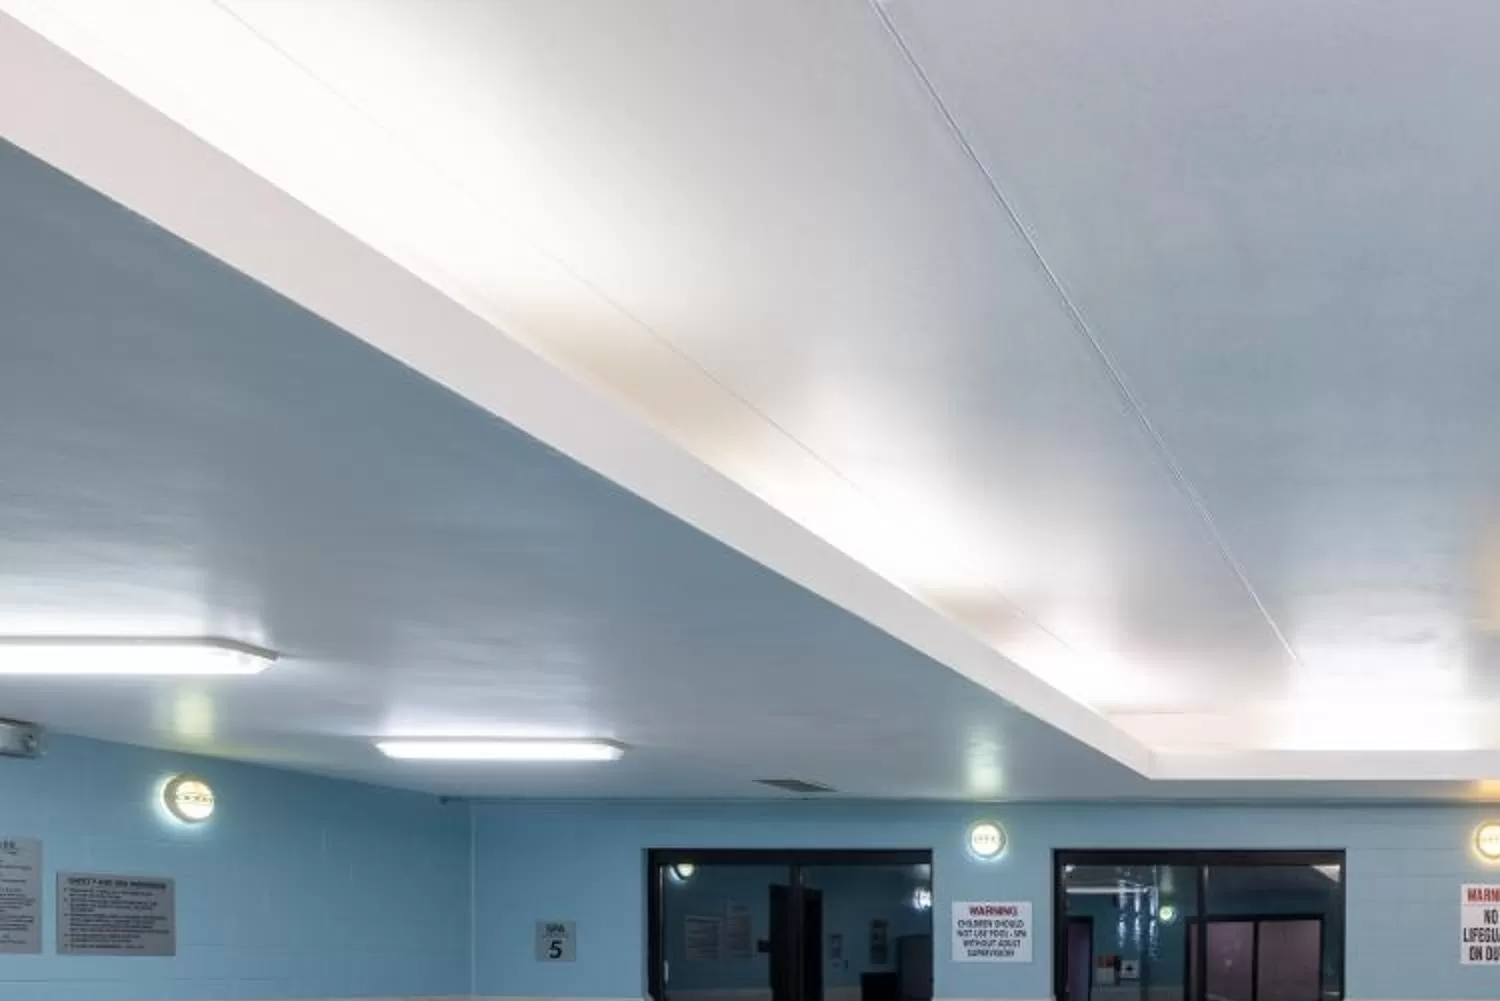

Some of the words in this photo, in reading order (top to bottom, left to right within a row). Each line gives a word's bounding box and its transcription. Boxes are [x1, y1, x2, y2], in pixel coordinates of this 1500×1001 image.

[969, 906, 1018, 917] WARNING
[1483, 909, 1499, 925] NO
[548, 940, 563, 959] 5
[1469, 945, 1483, 961] ON
